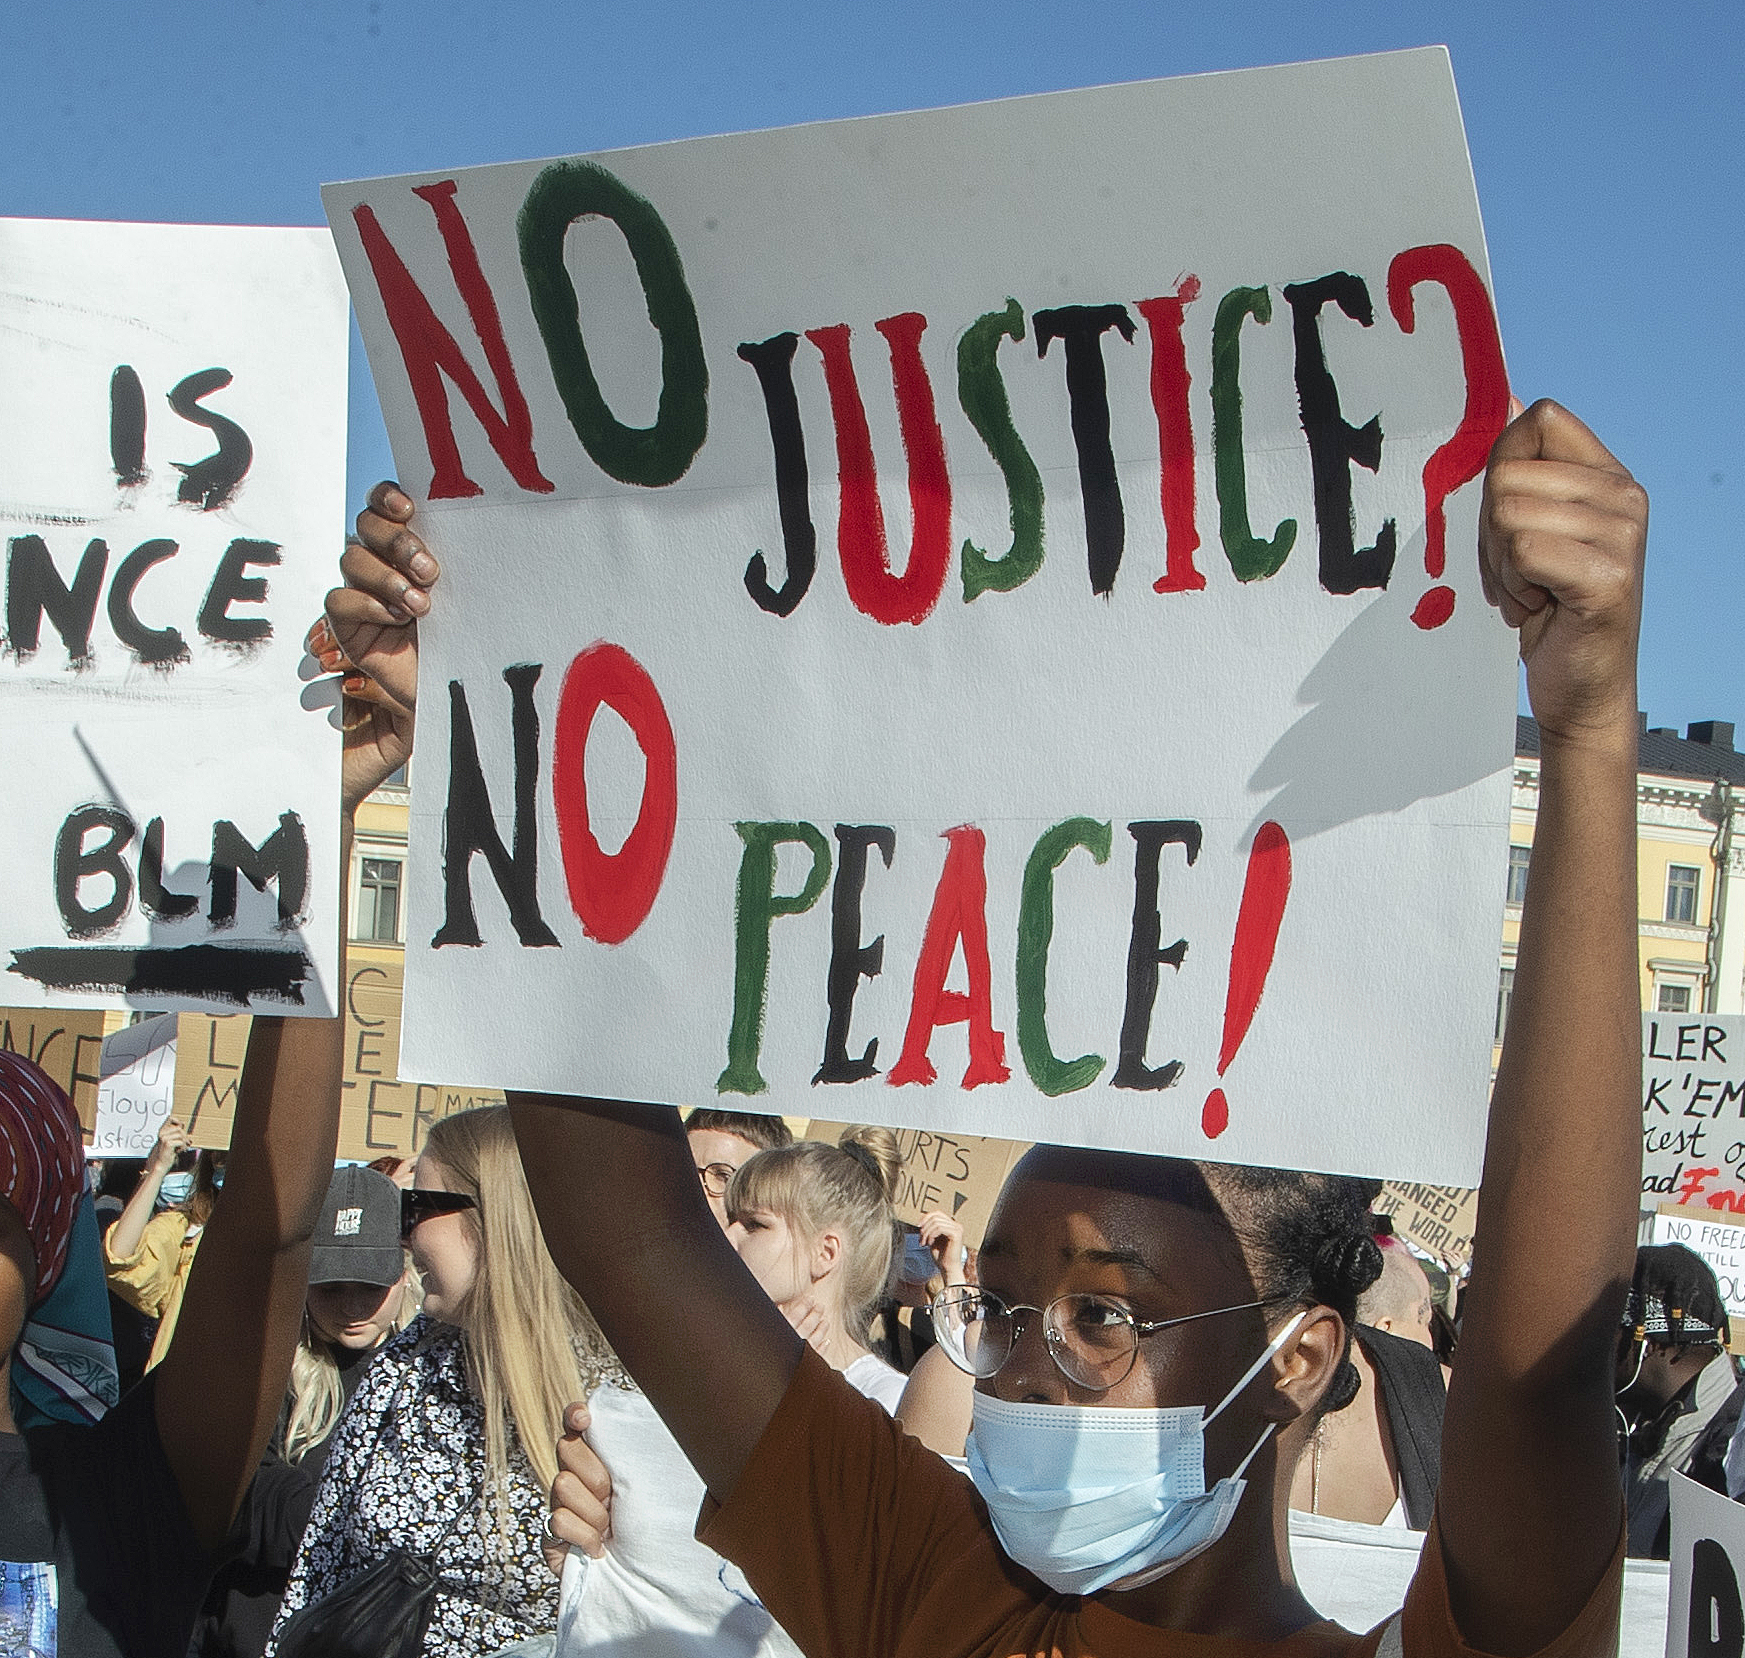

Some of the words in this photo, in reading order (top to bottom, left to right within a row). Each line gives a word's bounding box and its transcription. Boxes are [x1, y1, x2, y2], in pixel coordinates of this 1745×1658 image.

[109, 364, 254, 512] IS
[353, 161, 709, 499] NO
[737, 242, 1513, 630] JUSTICE?
[55, 801, 310, 940] BLM
[431, 638, 678, 946] NO
[715, 816, 1292, 1139] PEACE!
[1648, 1022, 1727, 1064] LER
[90, 1126, 156, 1151] ustice
[1642, 1162, 1684, 1194] ad
[1667, 1221, 1692, 1241] NO
